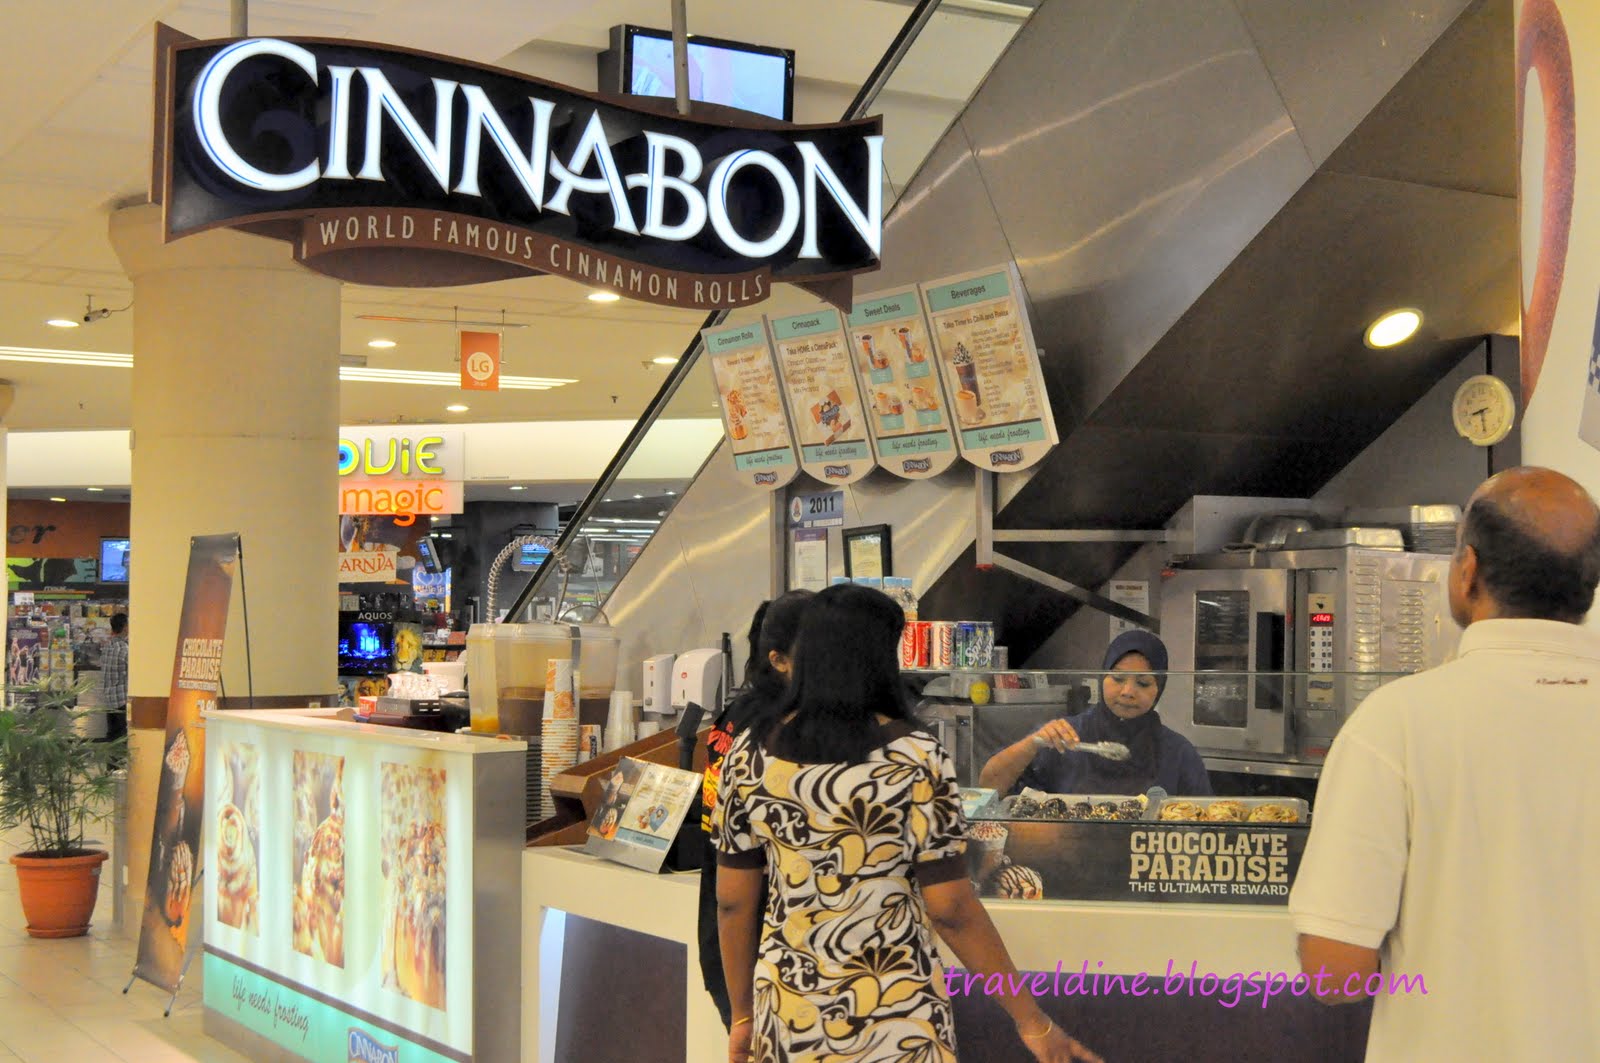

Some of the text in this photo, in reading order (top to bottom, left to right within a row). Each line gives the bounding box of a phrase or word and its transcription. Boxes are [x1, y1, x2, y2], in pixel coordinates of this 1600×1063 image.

[191, 38, 884, 260] CINNABON
[320, 214, 764, 304] WORLD FAMOUS CINNAMON ROLLS
[950, 285, 986, 299] Beverages
[863, 304, 901, 317] Sweet Deals
[792, 319, 820, 330] Cinnapack
[717, 333, 741, 346] Cinnamon
[471, 359, 490, 373] LG
[342, 483, 444, 527] magic
[810, 496, 834, 514] 2011
[357, 611, 393, 621] AQUOS
[179, 657, 221, 681] PARADISE
[1130, 831, 1288, 856] CHOCOLATE
[1129, 854, 1289, 883] PARADISE
[1128, 881, 1289, 896] THE ULTIMATE REWARD
[232, 975, 310, 1042] life needs frosting
